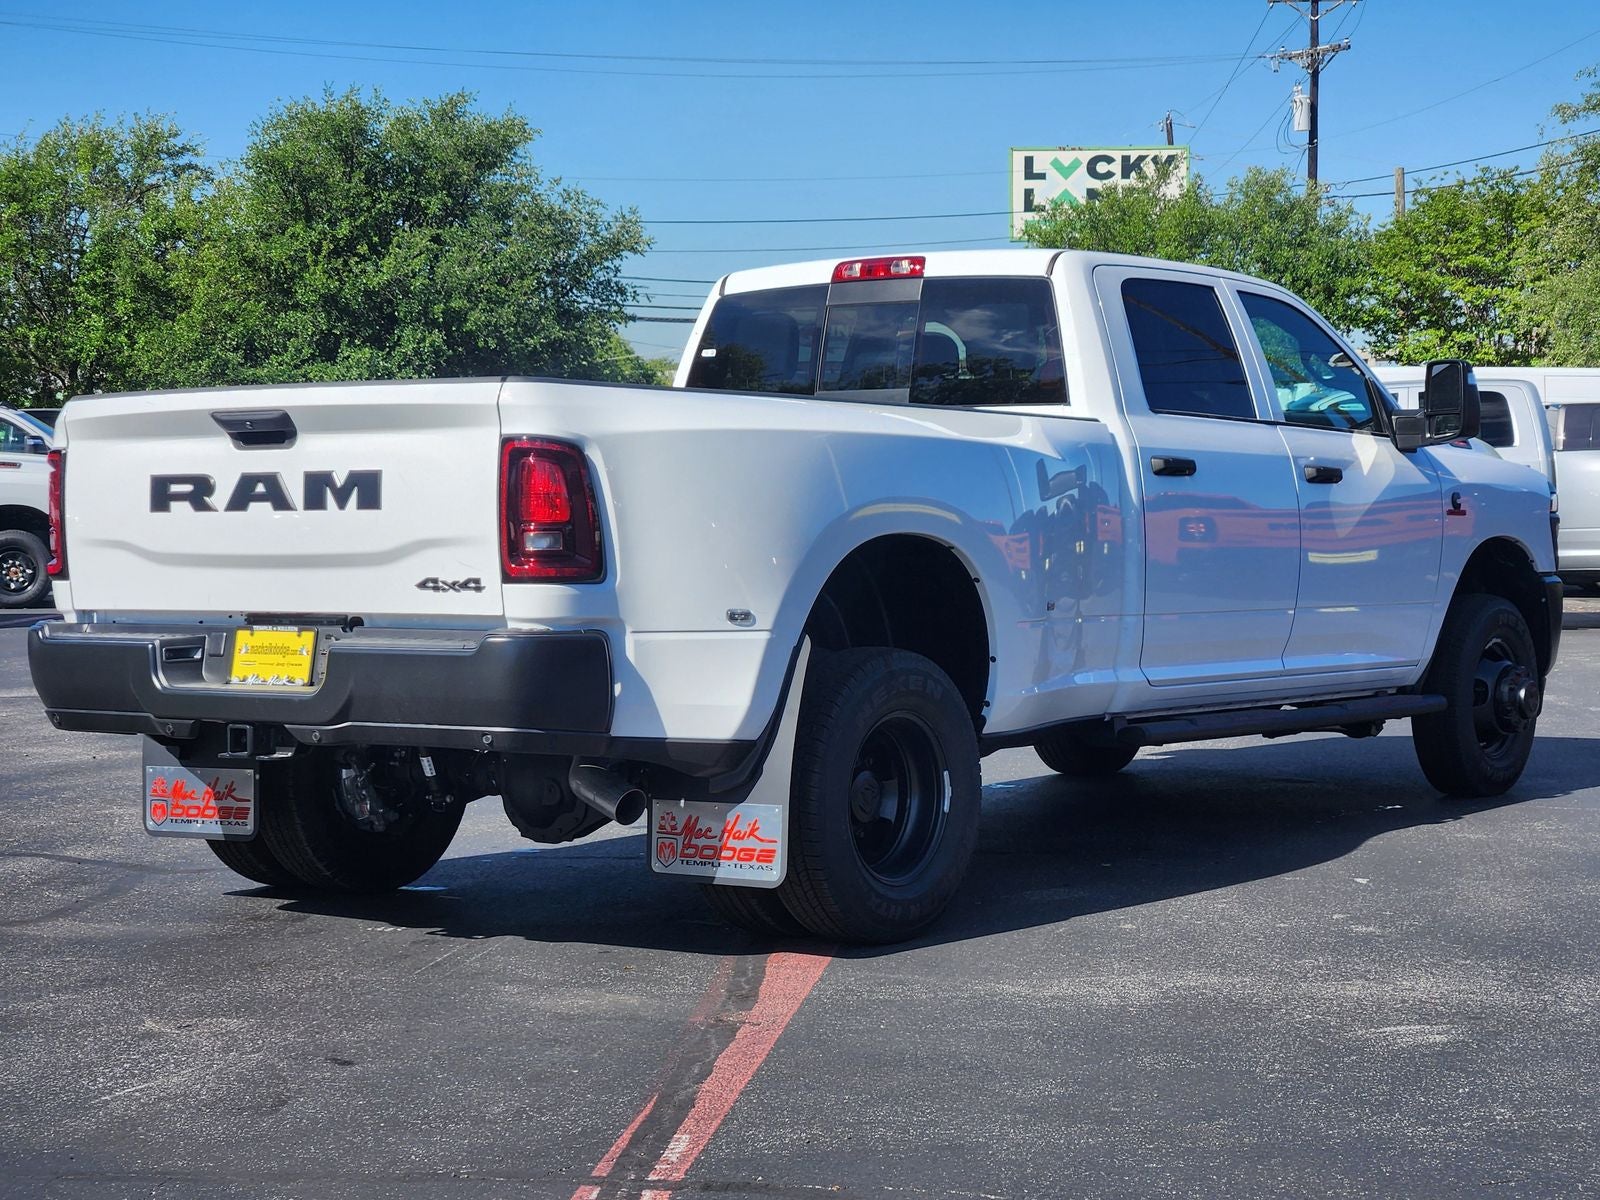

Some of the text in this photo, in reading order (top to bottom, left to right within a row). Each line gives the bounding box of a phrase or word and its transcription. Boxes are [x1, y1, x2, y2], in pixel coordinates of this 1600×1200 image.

[1024, 154, 1177, 181] LUCKY
[150, 469, 383, 513] RAM
[414, 576, 486, 593] 4x4
[170, 776, 251, 806] Mac Haik
[169, 803, 251, 820] DODGE
[680, 812, 778, 847] Mac Haik
[679, 844, 777, 864] DODGE
[681, 859, 774, 872] TEMPLE TEXAS
